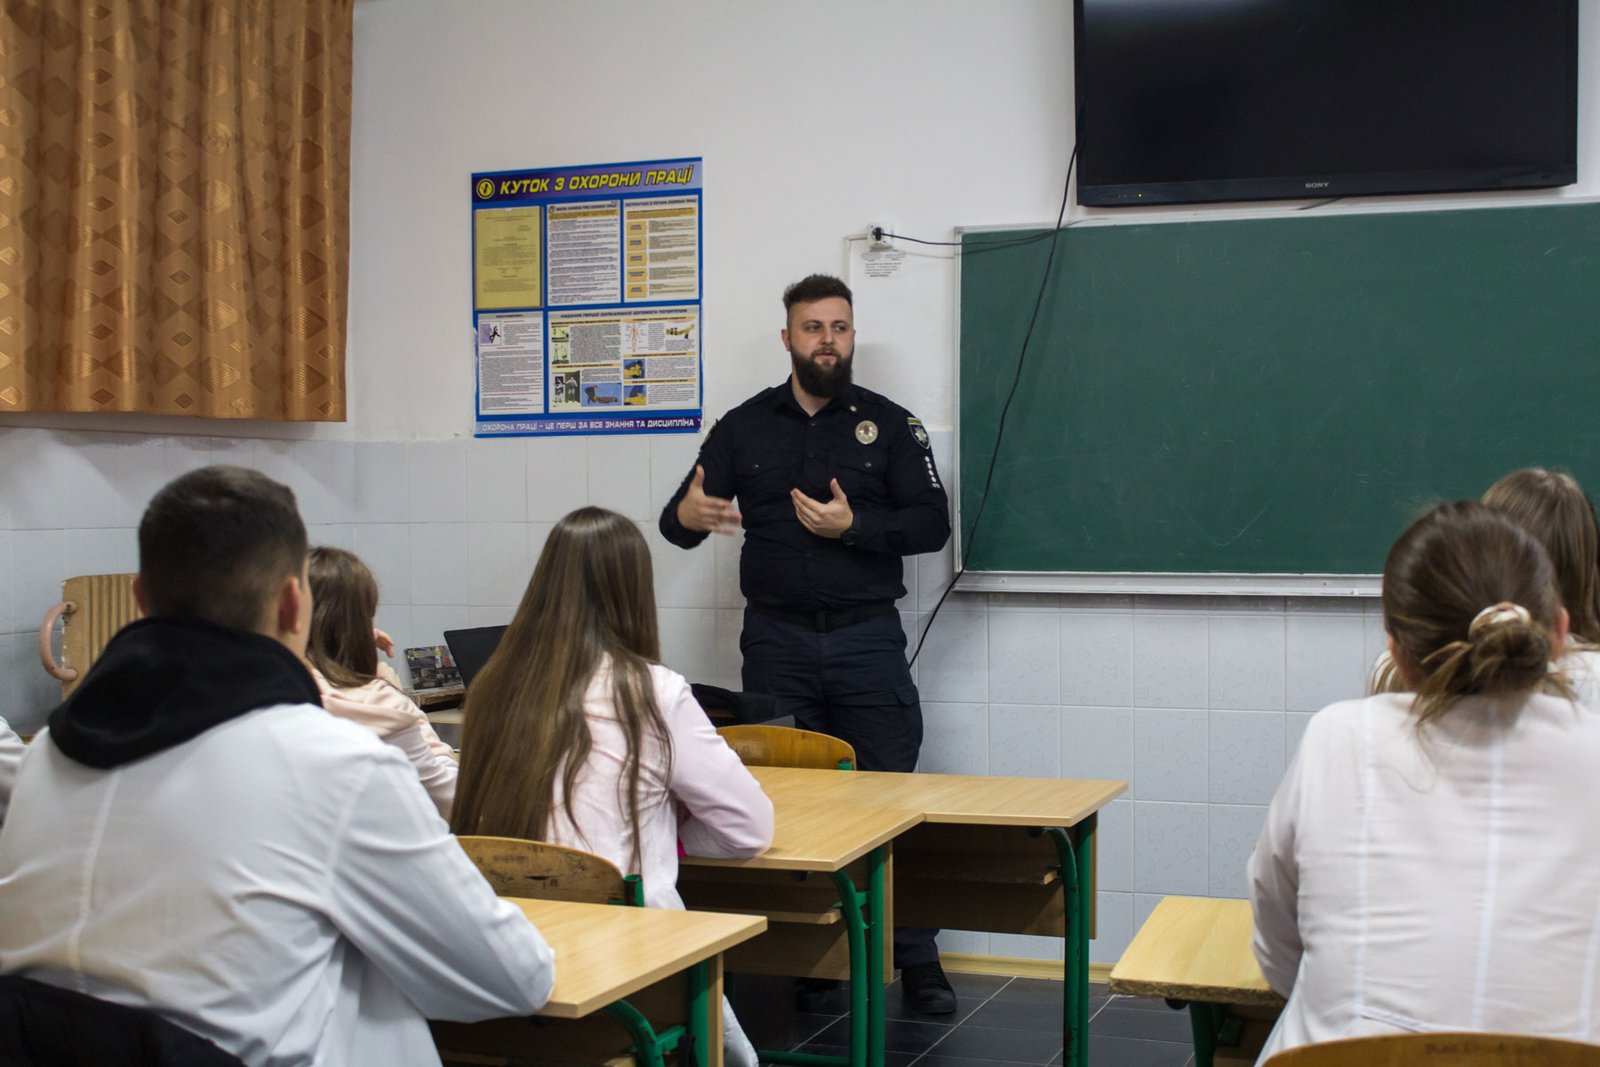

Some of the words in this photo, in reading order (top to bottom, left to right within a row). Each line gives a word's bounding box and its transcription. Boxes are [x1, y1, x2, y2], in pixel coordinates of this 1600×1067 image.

[499, 178, 549, 195] КУТОК
[553, 177, 565, 191] З
[568, 172, 642, 191] ОХОРОНИ
[645, 164, 695, 186] ПРАЦІ
[482, 424, 515, 432] ОХОРОНА
[516, 423, 538, 432] ПРАЦІ
[556, 422, 577, 430] ПЕРШ
[578, 421, 588, 429] ЗА
[589, 420, 603, 429] ВСЕ
[604, 420, 634, 428] ЗНАННЯ
[636, 420, 646, 428] ТА
[647, 417, 695, 428] ДИСЦИПЛІНА
